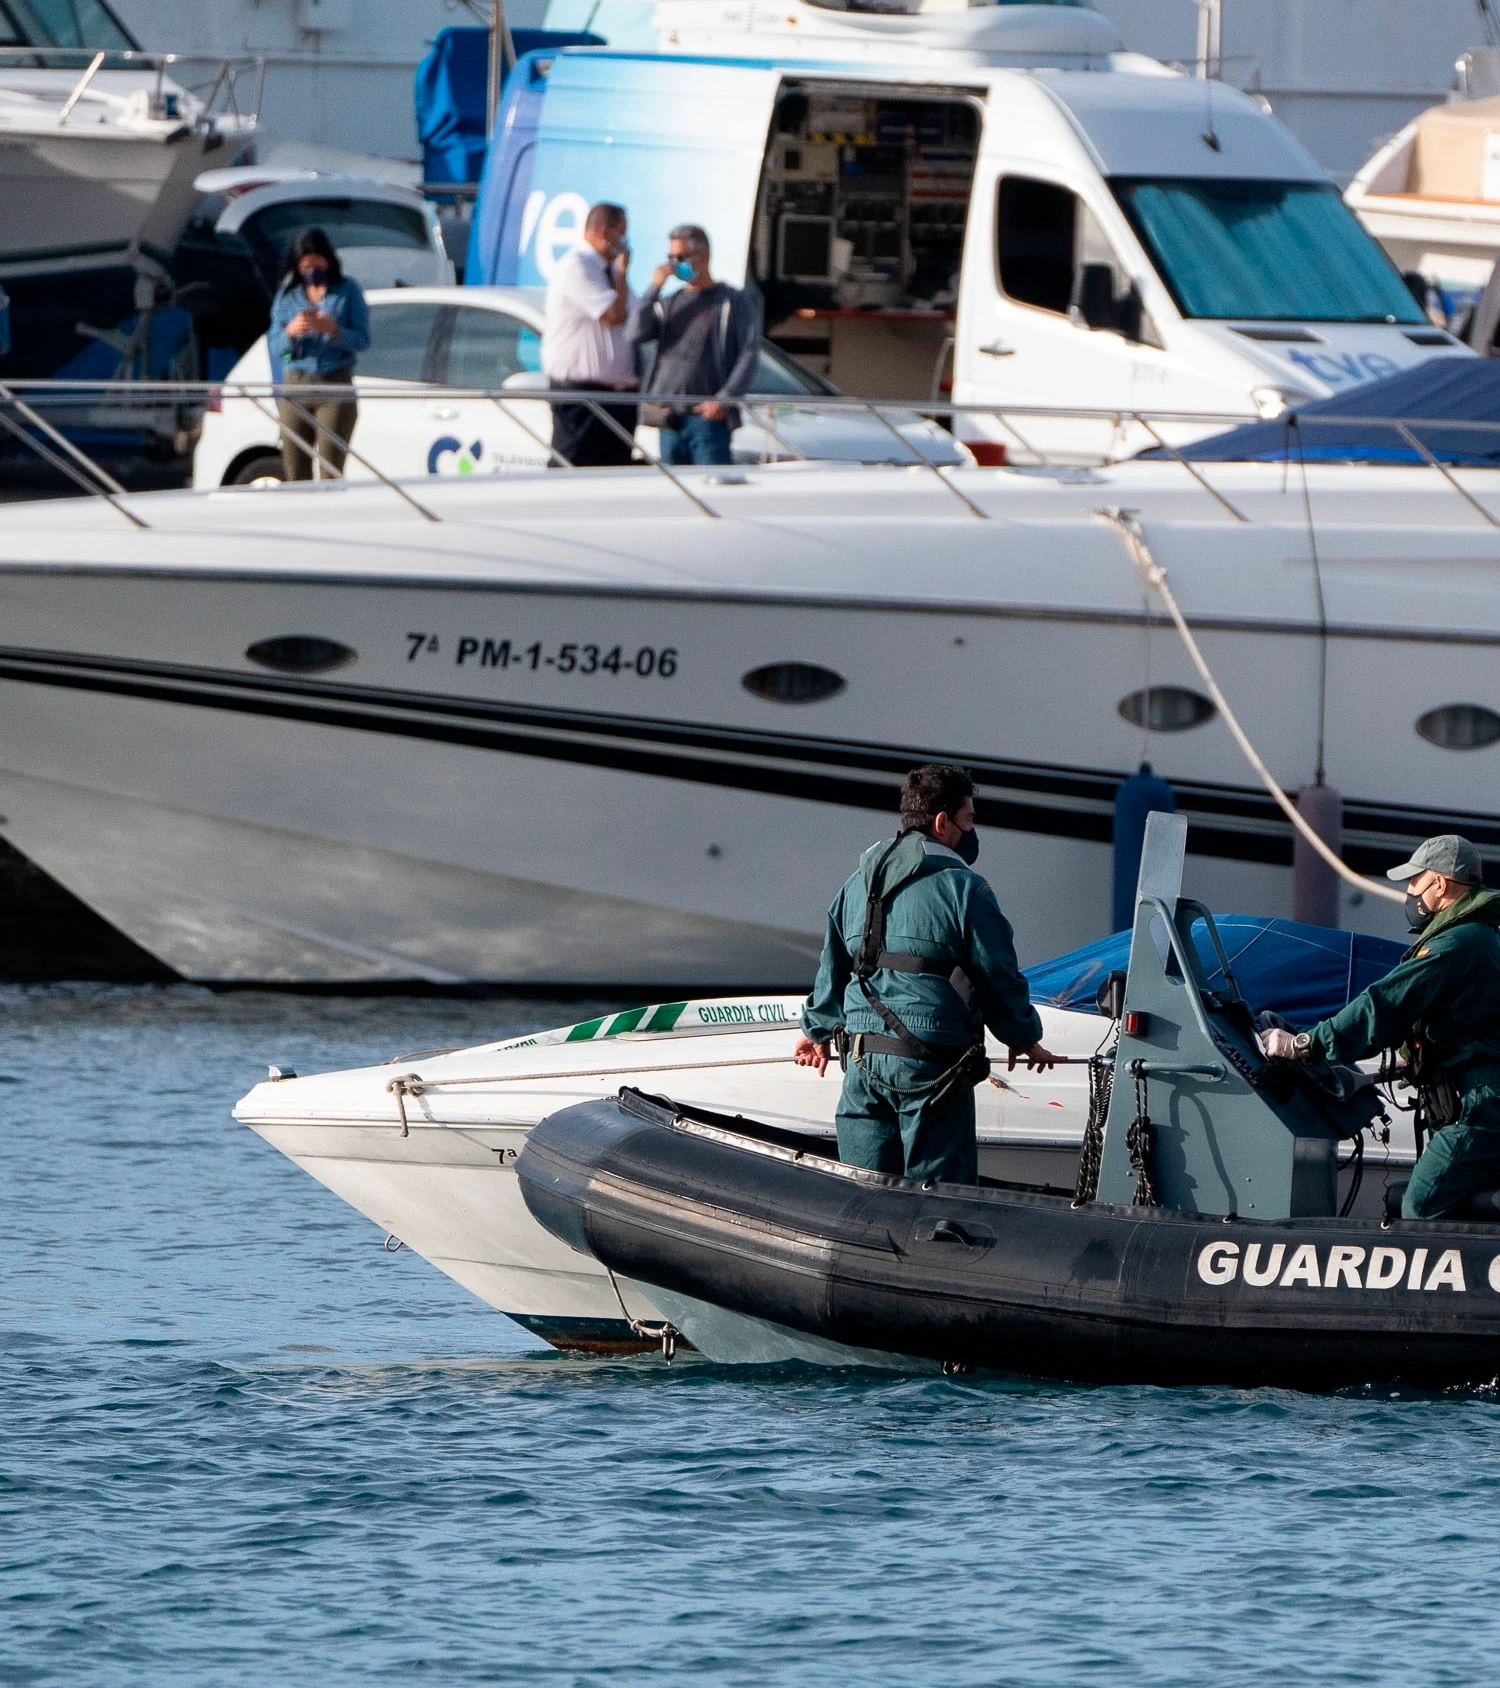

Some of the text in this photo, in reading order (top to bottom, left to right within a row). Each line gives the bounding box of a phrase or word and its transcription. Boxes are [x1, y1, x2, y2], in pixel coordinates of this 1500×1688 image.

[456, 636, 678, 678] PM-1-534-06
[698, 1005, 755, 1023] GUARDIA
[758, 1003, 789, 1024] CIVIL
[1197, 1240, 1467, 1292] GUARDIA
